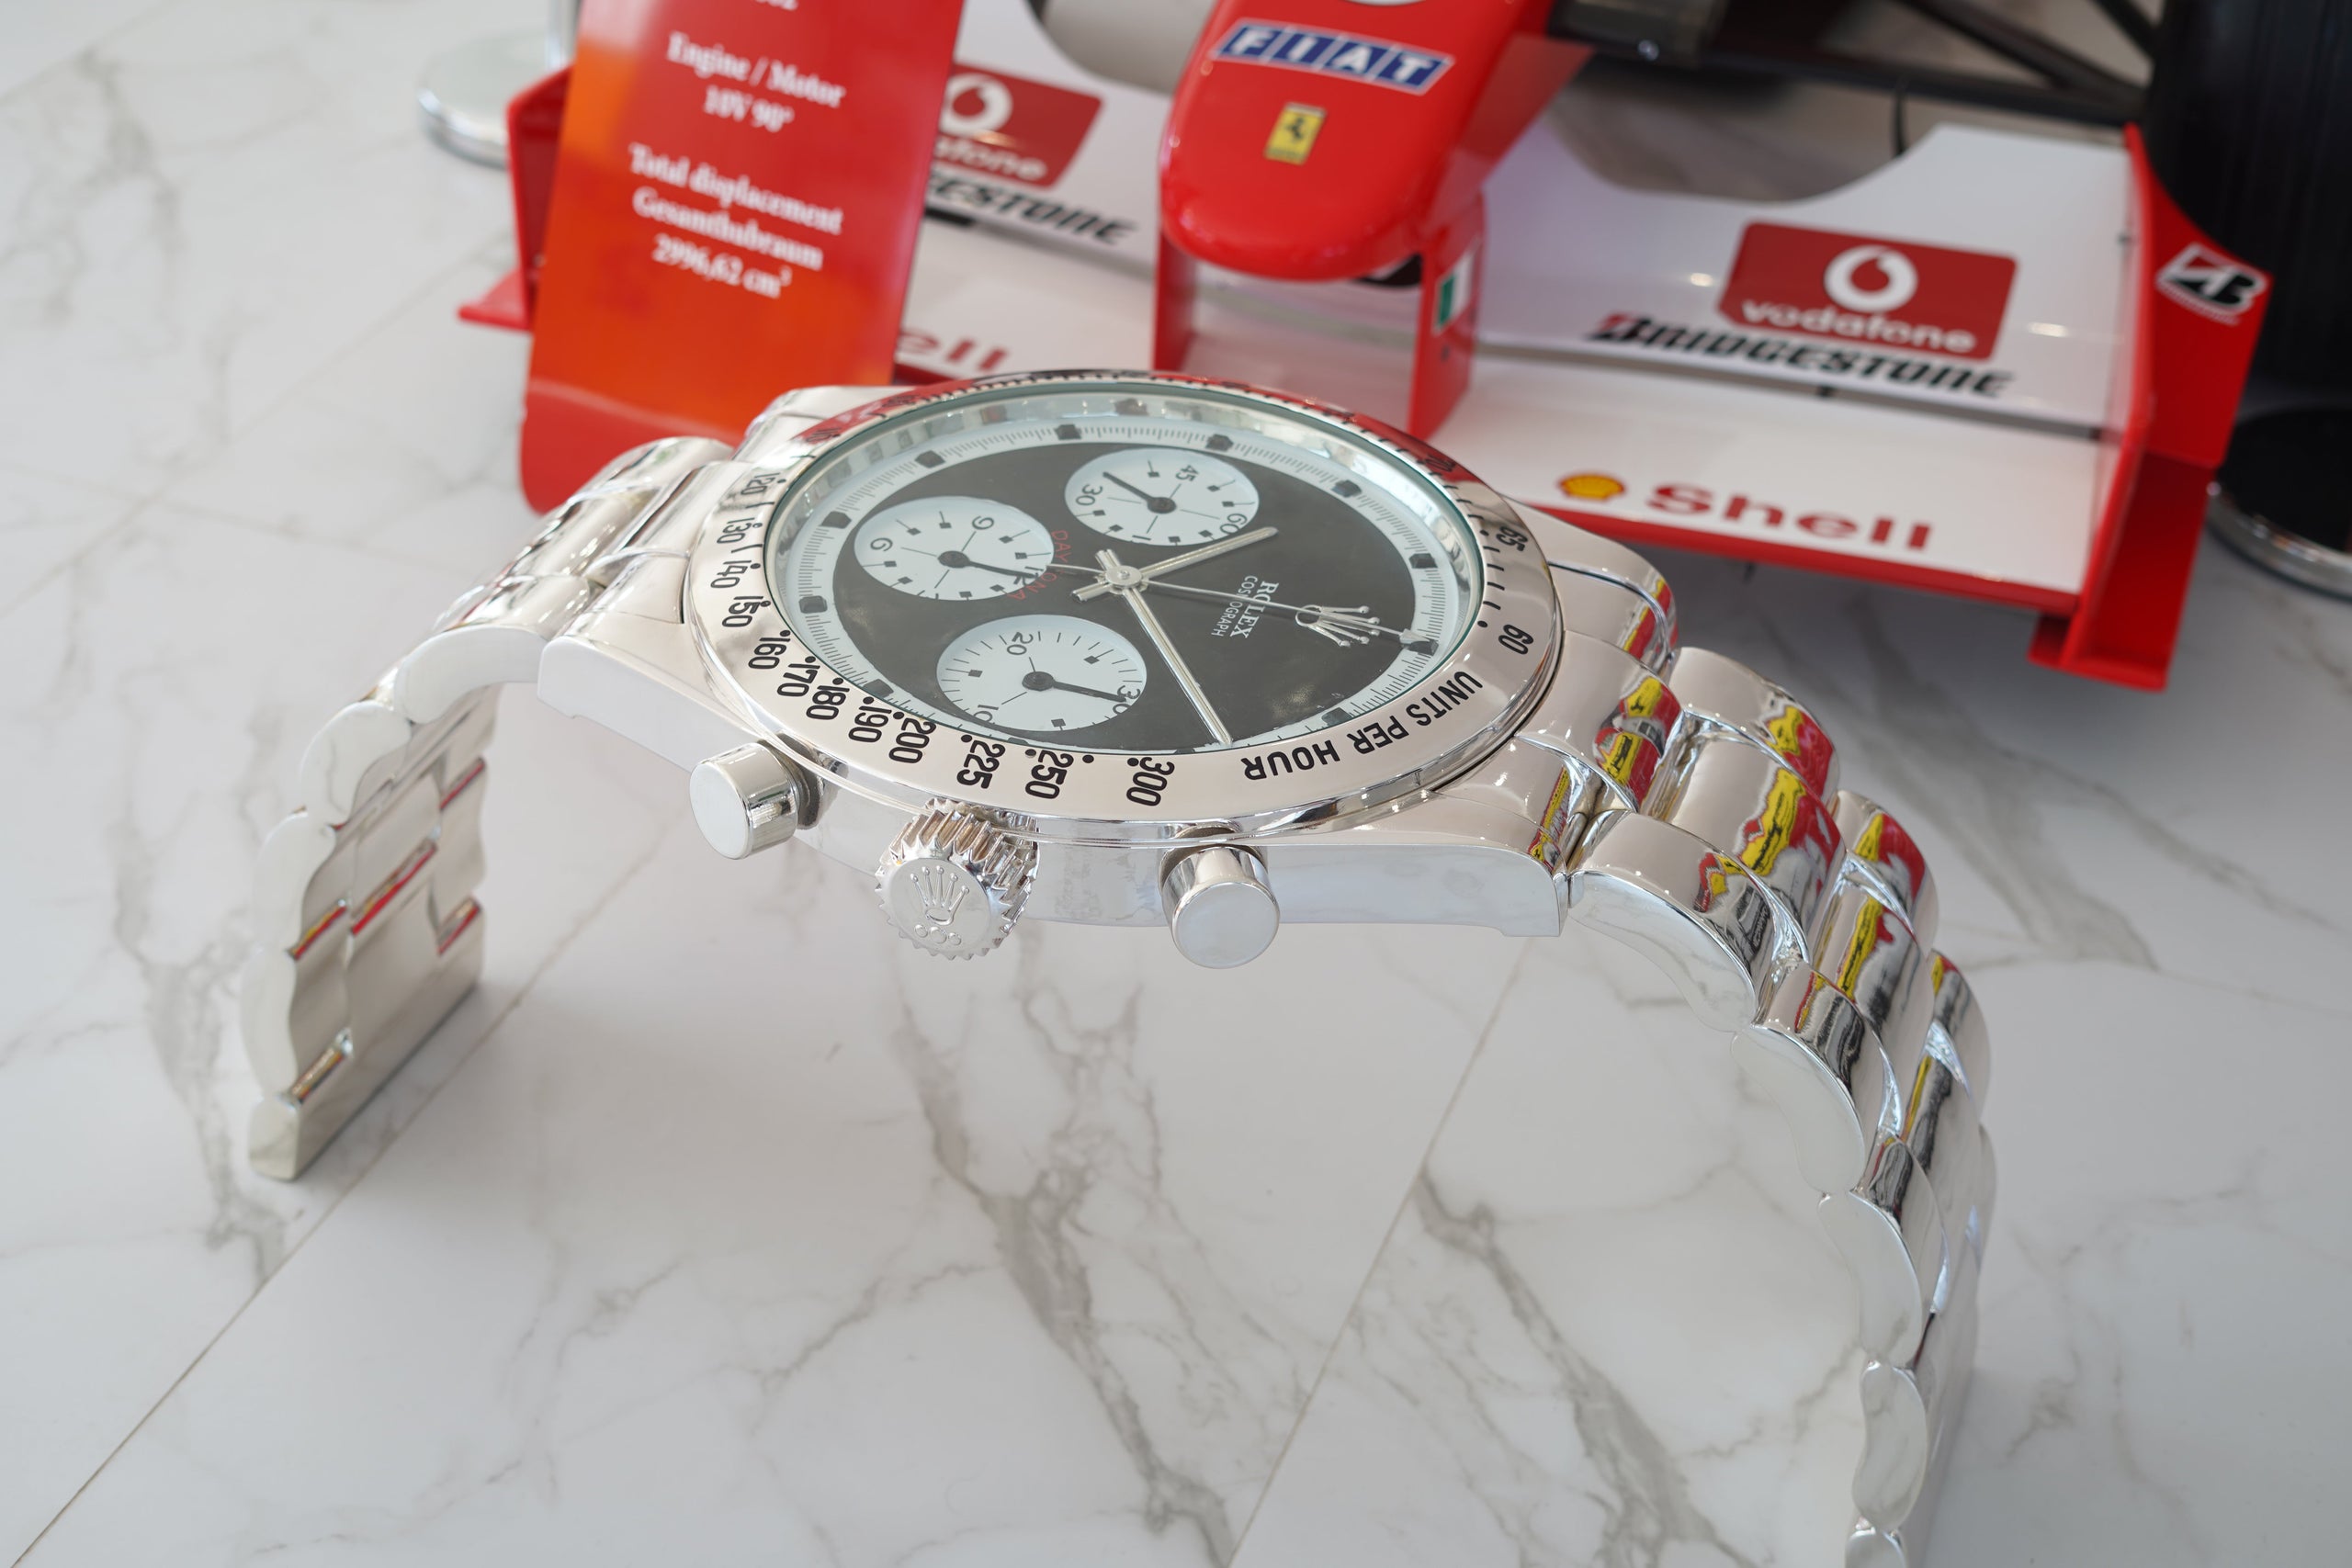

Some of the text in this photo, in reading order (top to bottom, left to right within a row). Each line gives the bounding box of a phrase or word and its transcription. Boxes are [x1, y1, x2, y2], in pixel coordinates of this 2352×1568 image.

[666, 30, 751, 80] Engine
[766, 60, 846, 108] Motor
[1229, 29, 1433, 83] FIAT
[628, 141, 843, 235] Total displacement
[1742, 300, 1977, 354] vodafone
[1582, 310, 2018, 398] BRIDGESTONE
[741, 472, 781, 496] 120
[1175, 464, 1200, 482] 45
[1075, 483, 1103, 506] 30
[716, 517, 756, 544] 130
[1219, 513, 1248, 536] 60
[1646, 482, 1932, 552] Shell
[1495, 525, 1529, 552] 65
[710, 559, 752, 589] 140
[1006, 529, 1071, 602] DAYONA
[721, 595, 764, 627] 150
[748, 637, 791, 670] 160
[1006, 631, 1035, 656] 20
[1498, 624, 1535, 655] 60
[776, 662, 821, 697] 170
[805, 684, 851, 721] 180
[848, 705, 893, 744] 190
[888, 716, 937, 764] 200
[1240, 669, 1485, 781] UNITS PER HOUR
[956, 739, 1007, 790] 225
[1024, 749, 1075, 800] 250
[1125, 755, 1176, 807] 300
